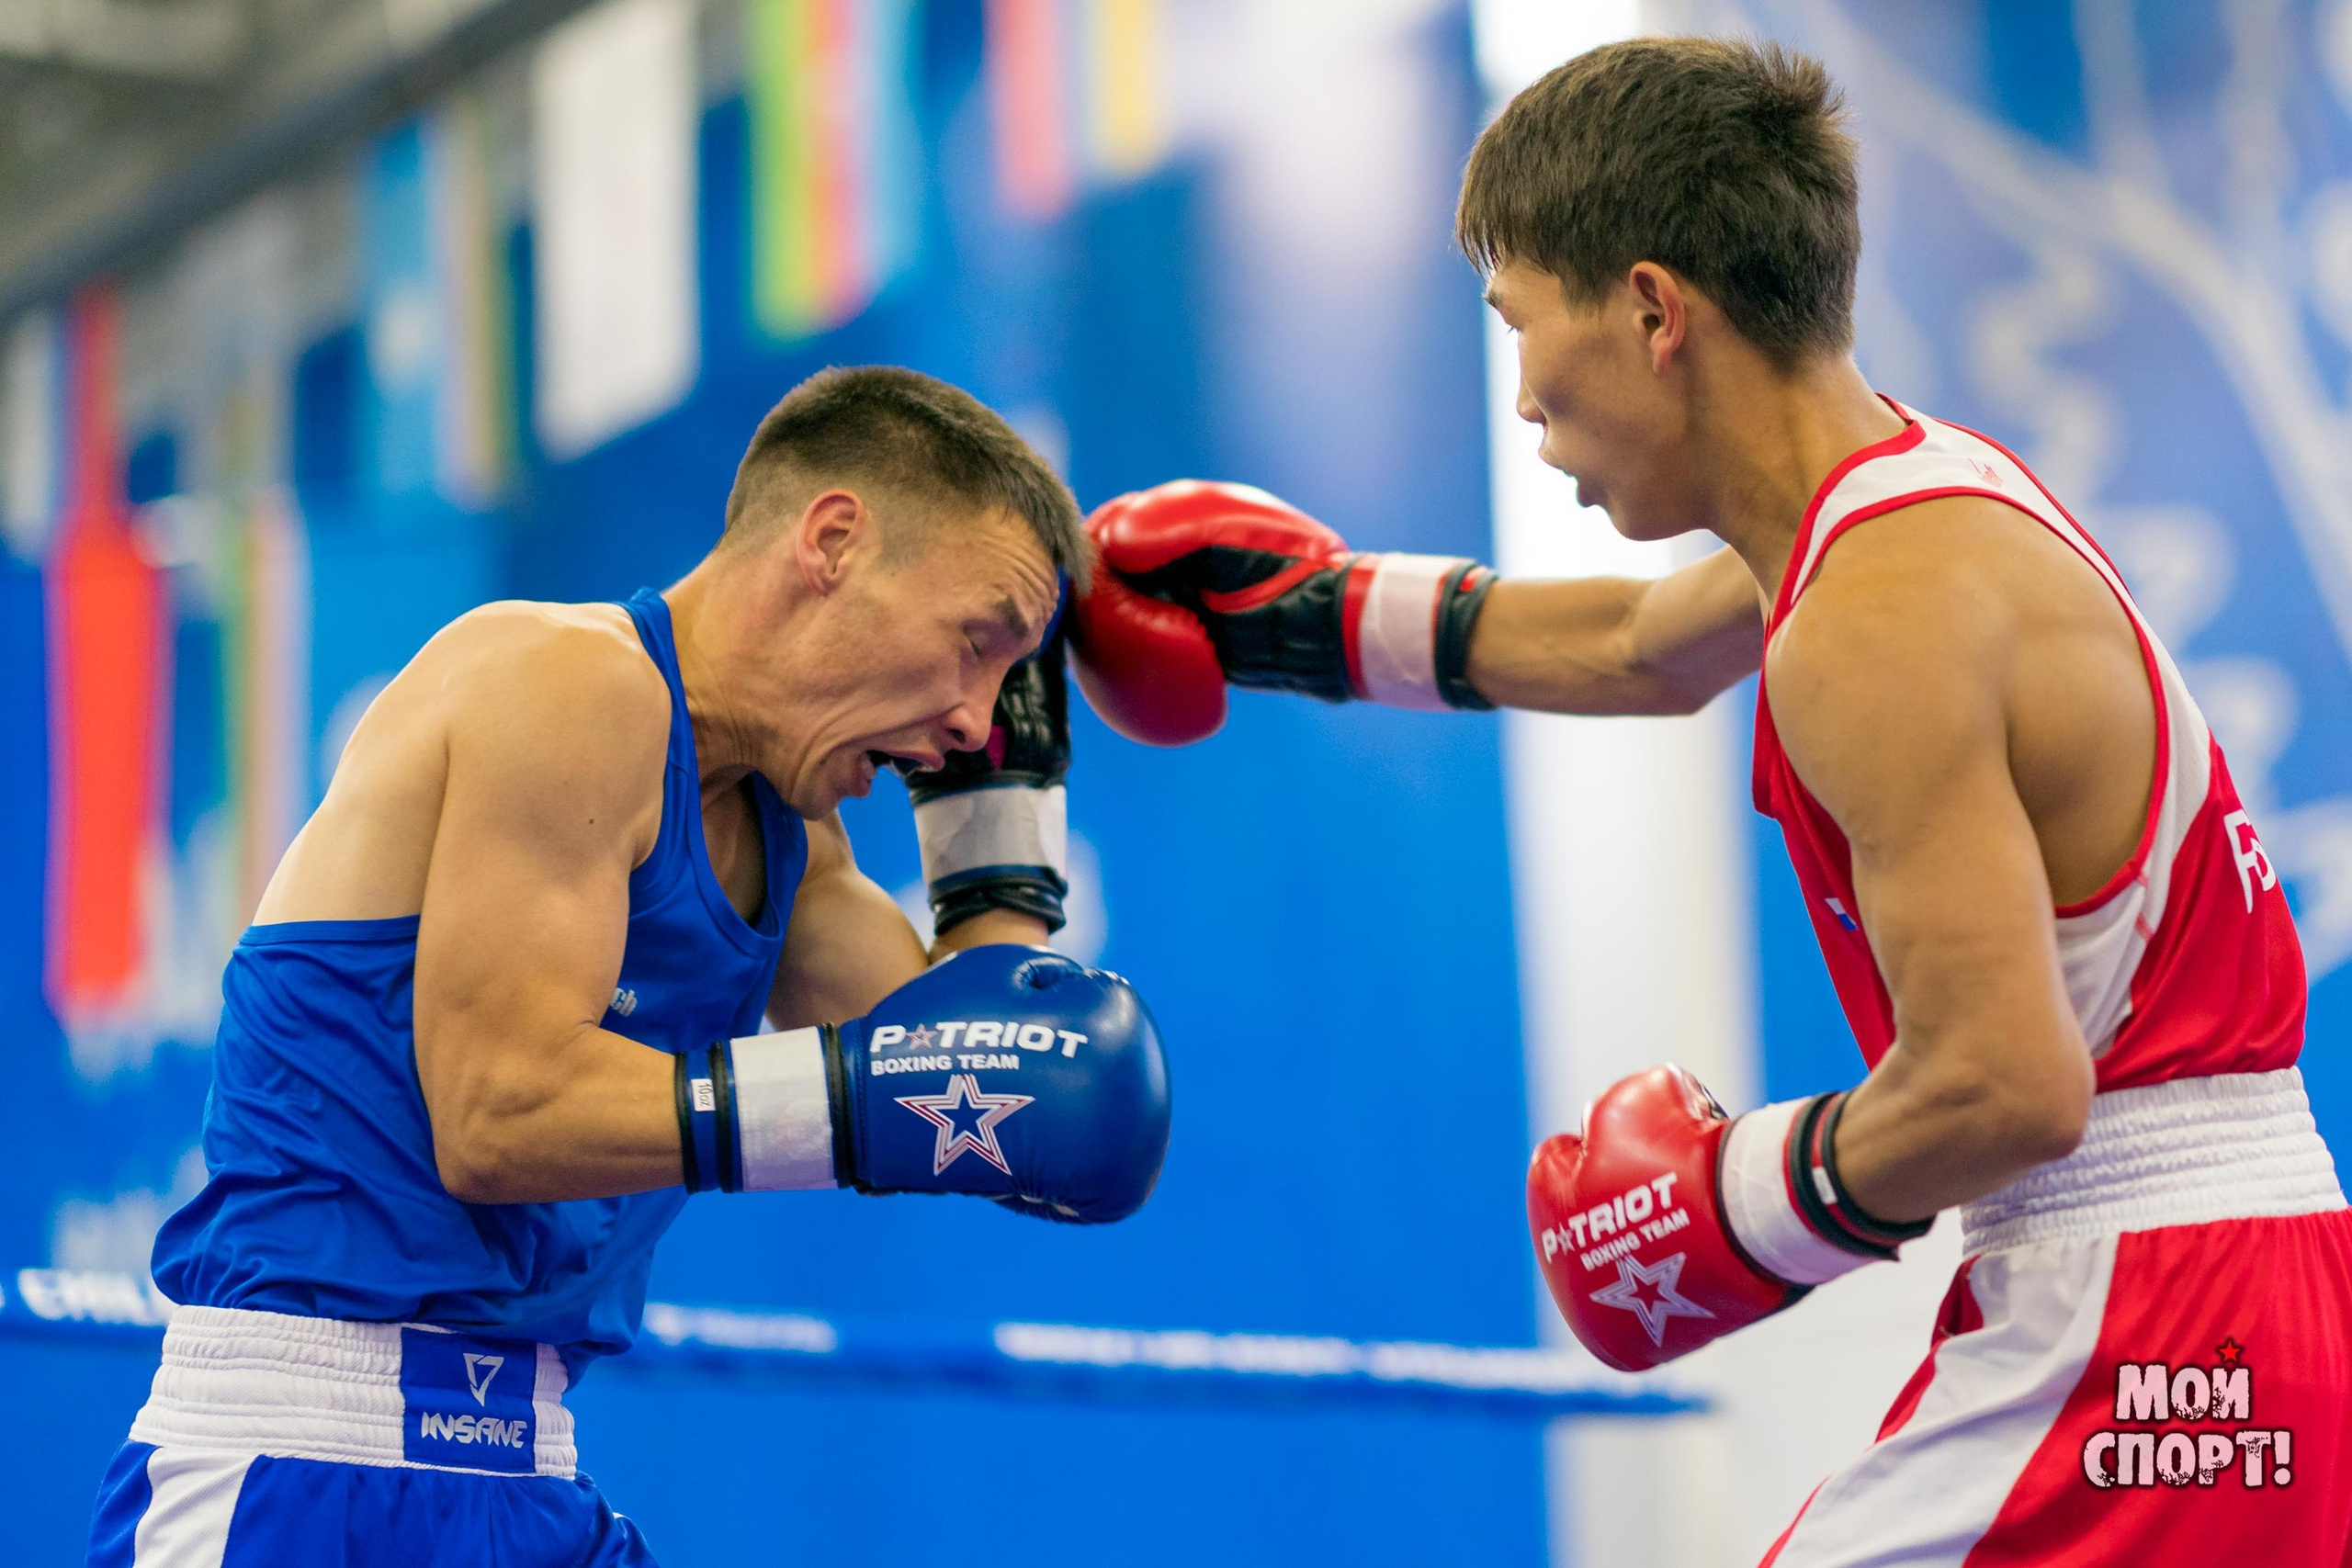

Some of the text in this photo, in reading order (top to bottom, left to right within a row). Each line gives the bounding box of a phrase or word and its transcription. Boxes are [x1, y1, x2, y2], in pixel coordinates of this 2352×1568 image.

[870, 1054, 1020, 1076] BOXING TEAM
[1579, 1207, 1690, 1272] BOXING TEAM
[421, 1411, 527, 1449] INSANE
